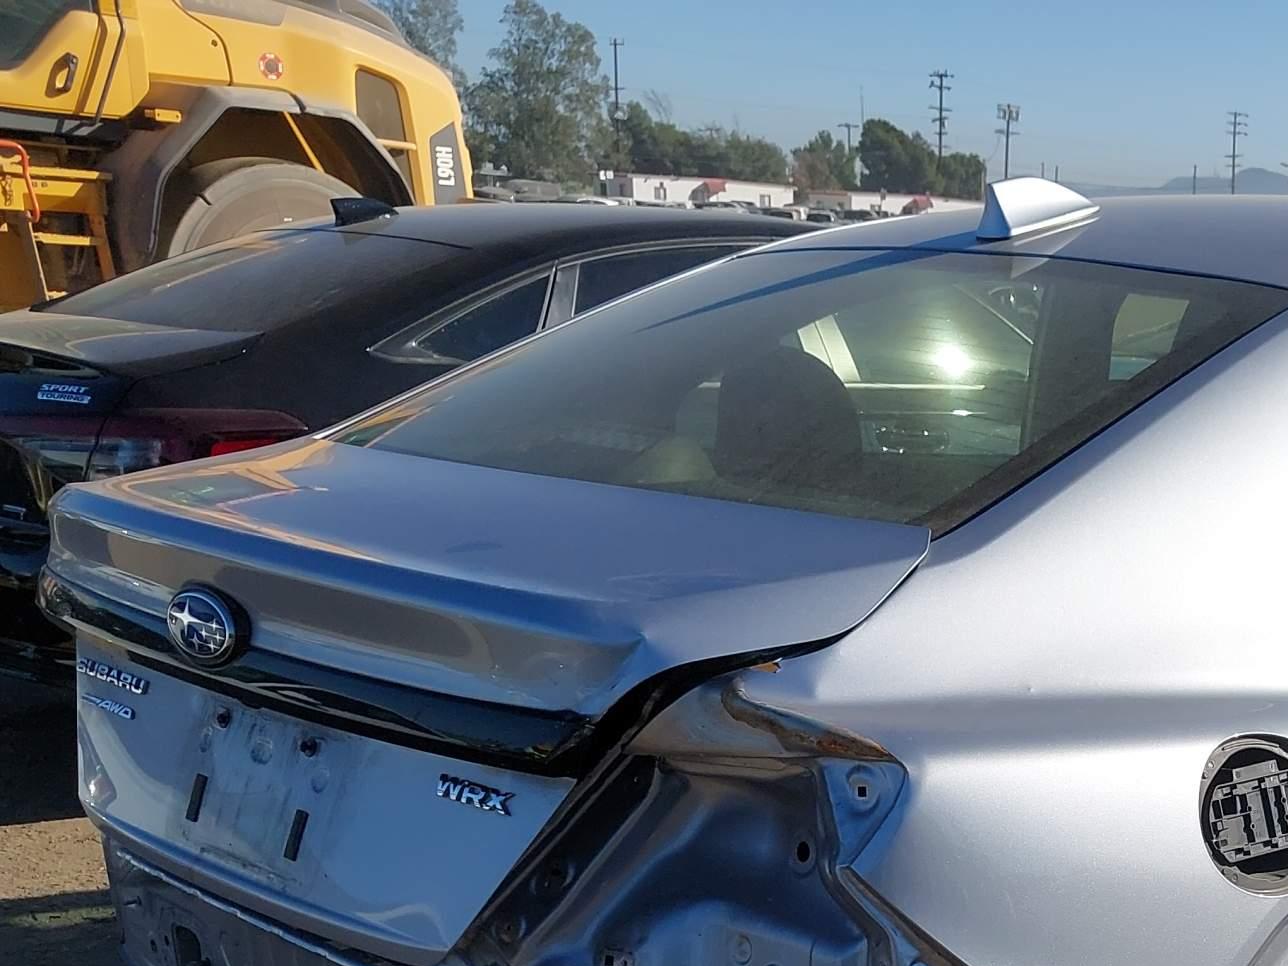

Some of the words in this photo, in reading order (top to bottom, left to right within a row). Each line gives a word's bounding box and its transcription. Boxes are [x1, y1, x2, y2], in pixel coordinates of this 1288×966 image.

[434, 146, 456, 187] L90H
[40, 384, 88, 393] SPORT
[77, 658, 145, 694] SUBARU
[98, 699, 133, 719] AWD
[436, 776, 513, 815] WRX
